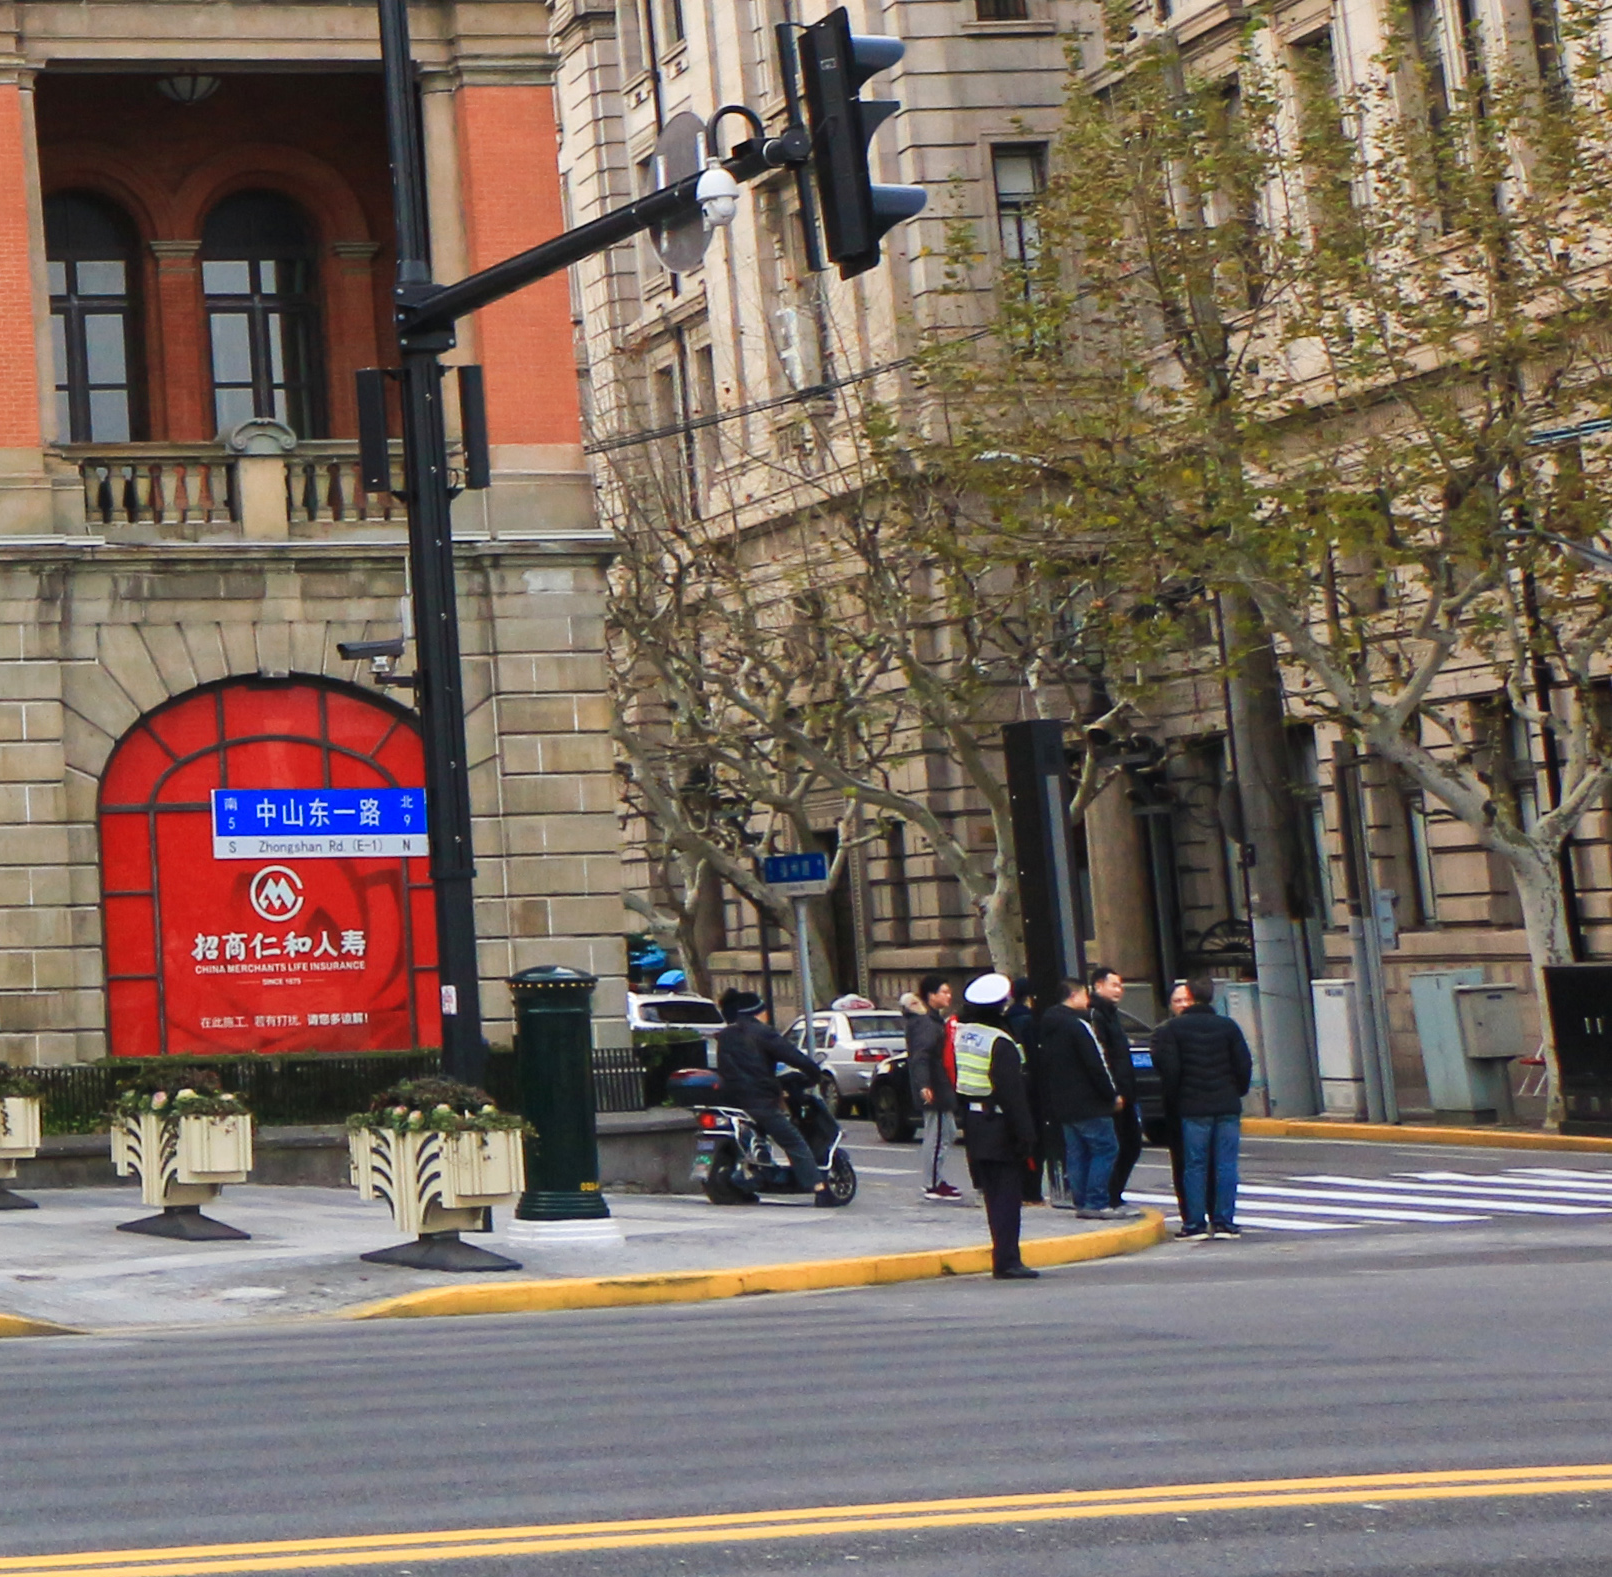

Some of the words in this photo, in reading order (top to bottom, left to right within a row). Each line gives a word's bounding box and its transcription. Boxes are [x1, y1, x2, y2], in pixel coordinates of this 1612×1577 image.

[224, 797, 238, 812] 南
[256, 797, 381, 828] 中山东一路
[400, 795, 414, 809] 北
[228, 817, 236, 830] 5
[403, 814, 411, 827] 9
[228, 841, 237, 853] S
[259, 840, 323, 854] Zhongshan
[329, 839, 347, 853] Rd.
[352, 839, 384, 852] (E-1)
[403, 839, 411, 851] N
[191, 929, 367, 961] 招商仁和人寿
[195, 965, 225, 974] CHINA
[227, 963, 287, 973] MERCHANTS
[288, 962, 308, 972] LIFE
[310, 961, 365, 971] INSURANCE
